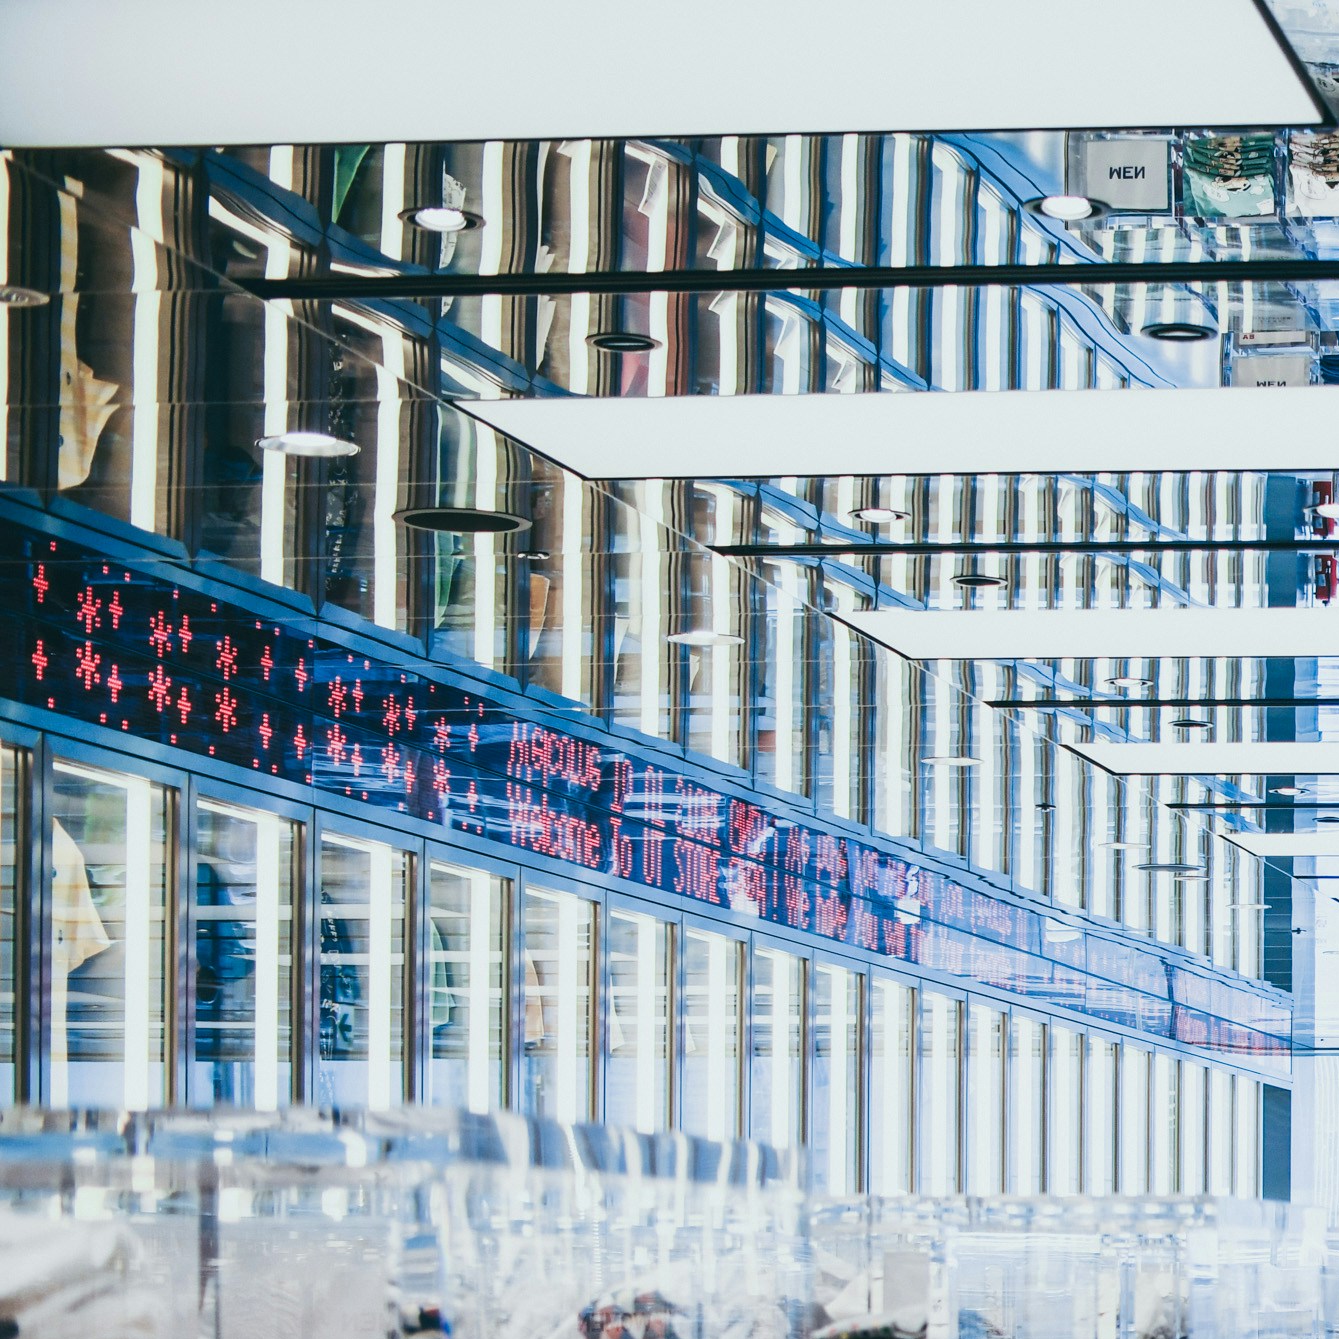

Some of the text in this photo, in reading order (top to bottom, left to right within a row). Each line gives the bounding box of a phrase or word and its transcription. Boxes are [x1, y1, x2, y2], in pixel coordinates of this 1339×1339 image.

[506, 782, 600, 868] Welcome
[643, 828, 665, 887] UT
[673, 837, 721, 903] STORE
[816, 882, 848, 941] hope
